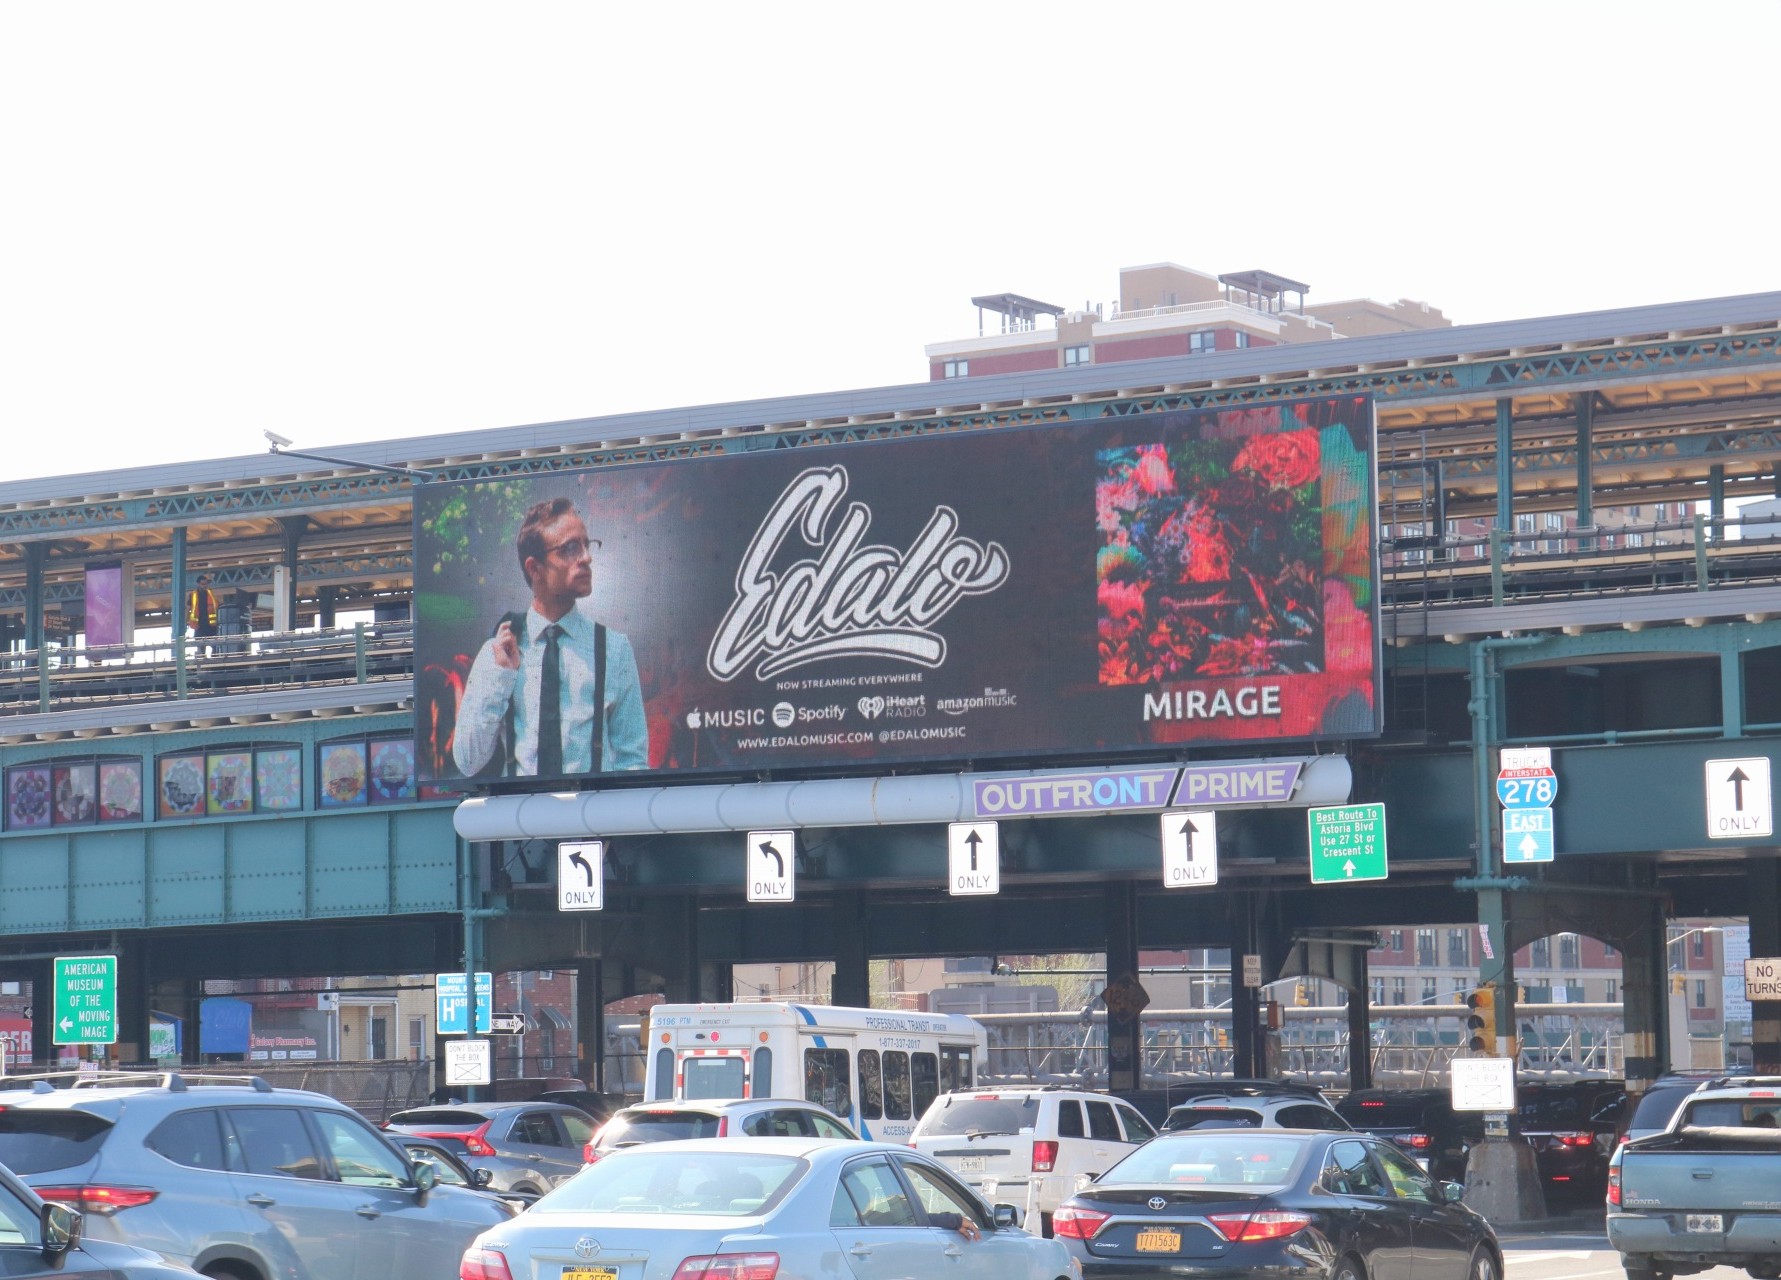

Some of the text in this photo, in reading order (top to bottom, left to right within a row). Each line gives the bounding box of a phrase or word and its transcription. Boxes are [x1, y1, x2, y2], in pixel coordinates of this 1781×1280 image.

[707, 464, 1010, 682] Edalo
[777, 673, 923, 690] NOW STREAMING EVERYWHERE
[886, 694, 926, 707] iHeart
[1143, 685, 1282, 721] MIRAGE
[704, 709, 765, 728] MUSIC
[798, 705, 846, 722] Spotify
[886, 706, 926, 718] RADIO
[737, 726, 966, 749] WWW.EDALOMUSIC.COM @EDALOMUSIC
[1507, 757, 1546, 768] TRUCKS
[1505, 768, 1547, 777] INTERSTATE
[981, 769, 1286, 812] OUTFRONT PRIME
[1504, 779, 1552, 803] 278
[1316, 808, 1377, 822] Best Route To
[1511, 812, 1544, 830] EAST
[1320, 821, 1374, 834] Astoria Blvd
[1719, 816, 1760, 831] ONLY
[1320, 834, 1376, 846] Use 27 St or
[1323, 844, 1374, 857] Crescent St
[1172, 866, 1208, 881] ONLY
[957, 875, 991, 888] ONLY
[754, 882, 787, 895] ONLY
[565, 891, 595, 904] ONLY
[64, 963, 107, 976] AMERICAN
[1756, 966, 1773, 977] NO
[67, 979, 104, 991] MUSEUM
[447, 976, 467, 984] MOUNT
[475, 984, 490, 992] UEENS
[1747, 983, 1781, 994] TURNS
[69, 994, 101, 1007] OF THE
[78, 1010, 110, 1022] MOVING
[657, 1017, 676, 1026] 5196
[491, 1020, 519, 1028] NE WAY
[865, 1017, 908, 1031] PROFESSIONAL
[907, 1020, 930, 1032] TRANSIT
[81, 1026, 108, 1038] IMAGE
[449, 1044, 486, 1053] DON'T BLOCK
[879, 1037, 921, 1049] 1-877-337-2017
[456, 1053, 480, 1062] THE BOX
[1140, 1234, 1178, 1247] T771563C
